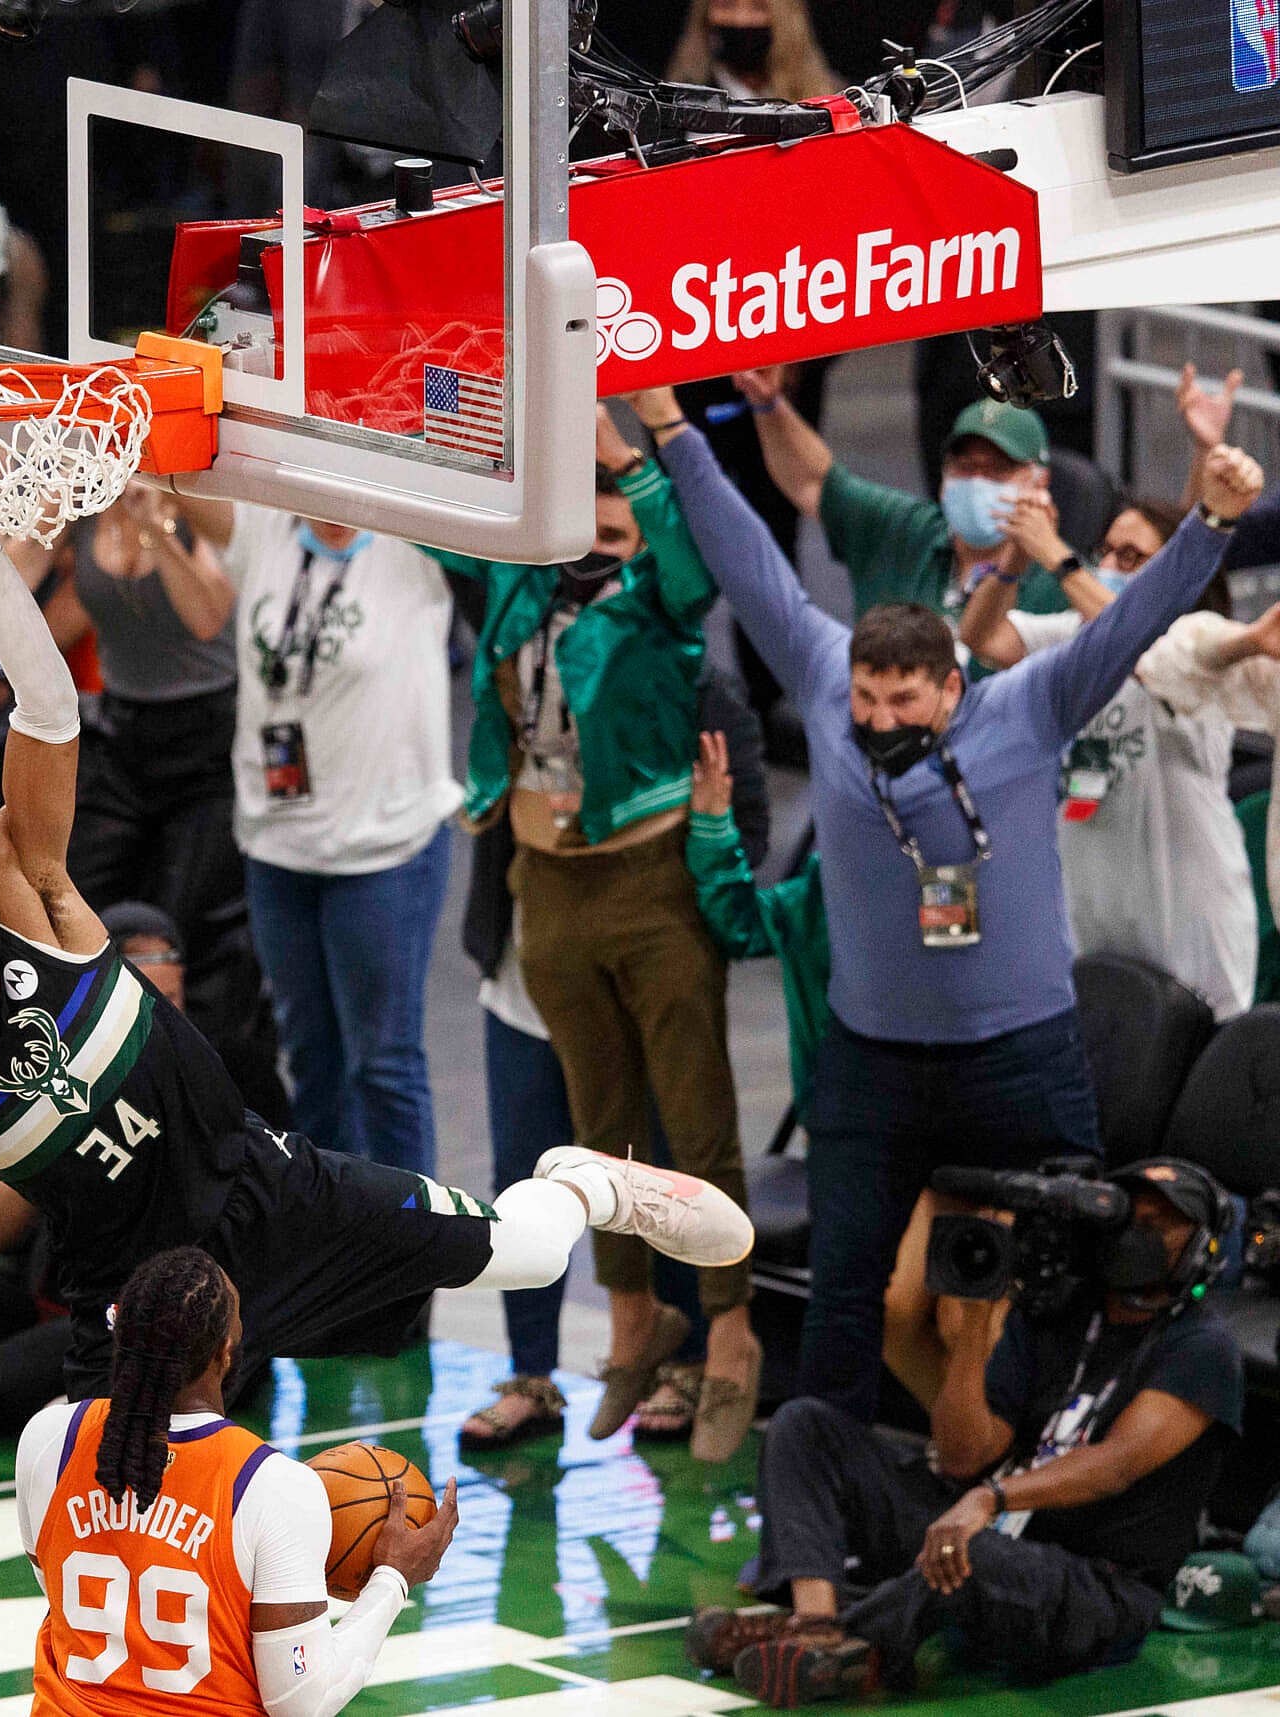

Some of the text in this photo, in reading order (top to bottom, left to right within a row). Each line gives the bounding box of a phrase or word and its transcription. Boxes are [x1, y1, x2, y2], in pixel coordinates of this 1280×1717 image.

[75, 1098, 161, 1181] 34
[66, 1488, 214, 1560] CROWDER
[62, 1550, 212, 1694] 99
